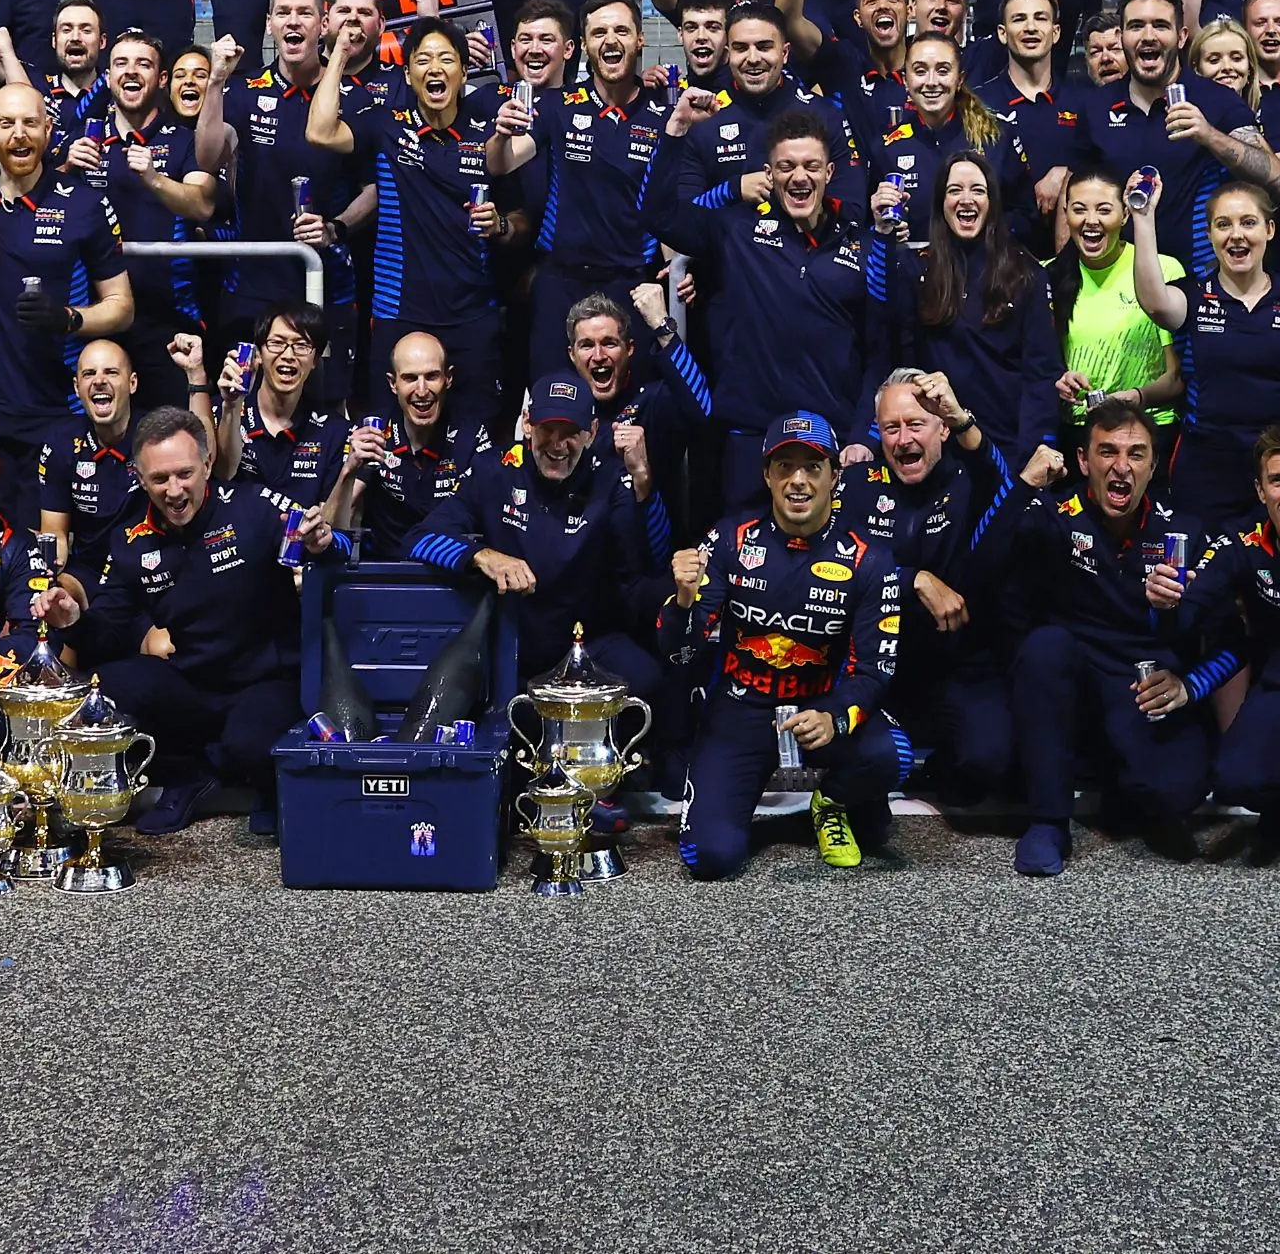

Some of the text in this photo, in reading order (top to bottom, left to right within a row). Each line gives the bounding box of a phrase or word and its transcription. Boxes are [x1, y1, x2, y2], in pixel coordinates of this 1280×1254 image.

[274, 73, 288, 89] zoom
[590, 91, 603, 108] zoom
[413, 110, 423, 127] zoom
[631, 143, 653, 153] BYBIT
[461, 157, 483, 166] BYBIT
[36, 227, 61, 235] BYBIT
[834, 258, 860, 270] HONDA
[87, 433, 97, 451] zoom
[294, 461, 317, 470] BYBIT
[503, 517, 527, 531] ORACLE
[868, 517, 888, 526] Mbil
[927, 514, 946, 523] BYBI
[204, 524, 233, 538] ORACLE
[1072, 533, 1092, 541] TAG
[211, 548, 238, 563] BYBIT
[742, 547, 765, 557] TAG
[212, 559, 244, 573] HONDA
[822, 565, 848, 577] RAUCH
[147, 581, 174, 593] ORACLE
[729, 574, 754, 588] Mobil
[809, 587, 847, 603] BYBIT
[805, 604, 846, 615] HONDA
[730, 601, 844, 635] ORACLE
[724, 653, 832, 698] Red Bull
[367, 779, 404, 791] YETI
